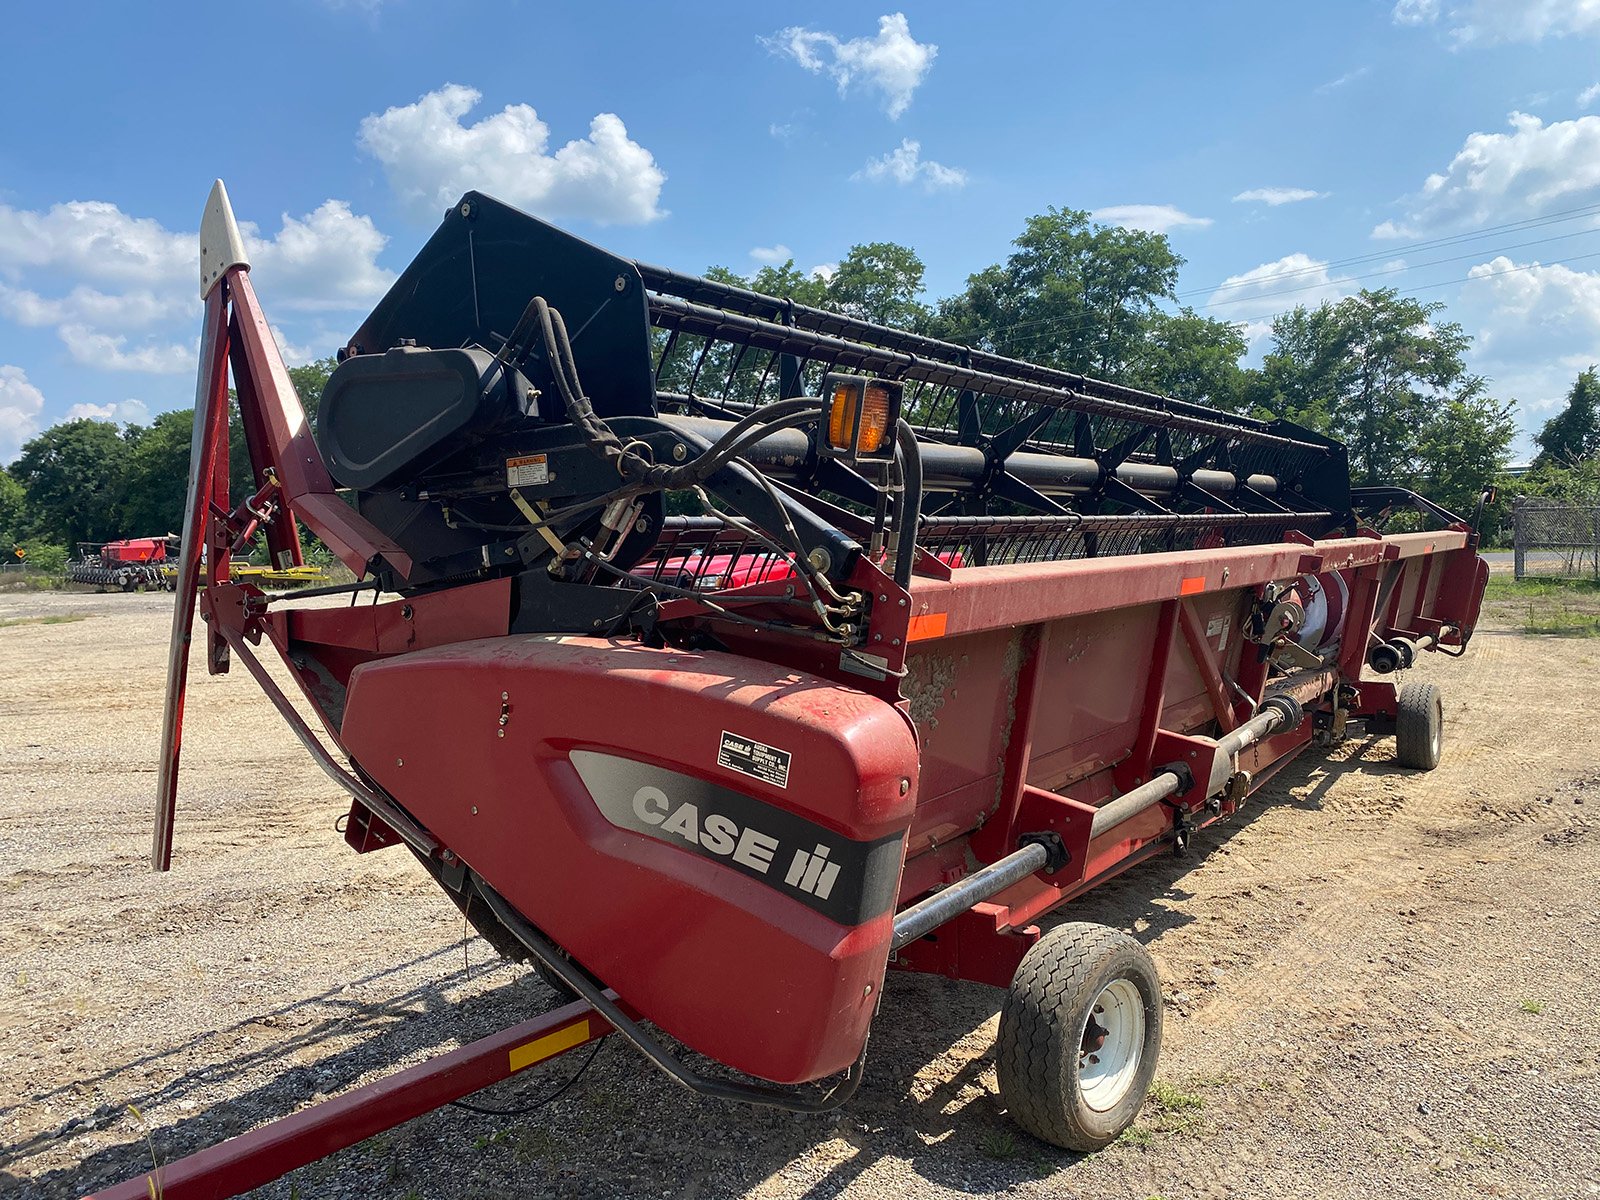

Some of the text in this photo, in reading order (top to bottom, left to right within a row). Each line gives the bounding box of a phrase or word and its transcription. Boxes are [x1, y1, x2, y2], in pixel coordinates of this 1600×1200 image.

[724, 739, 744, 749] CASE
[752, 755, 768, 765] SUPPLY
[753, 749, 777, 762] EQUIPMENT
[633, 786, 779, 874] CASE
